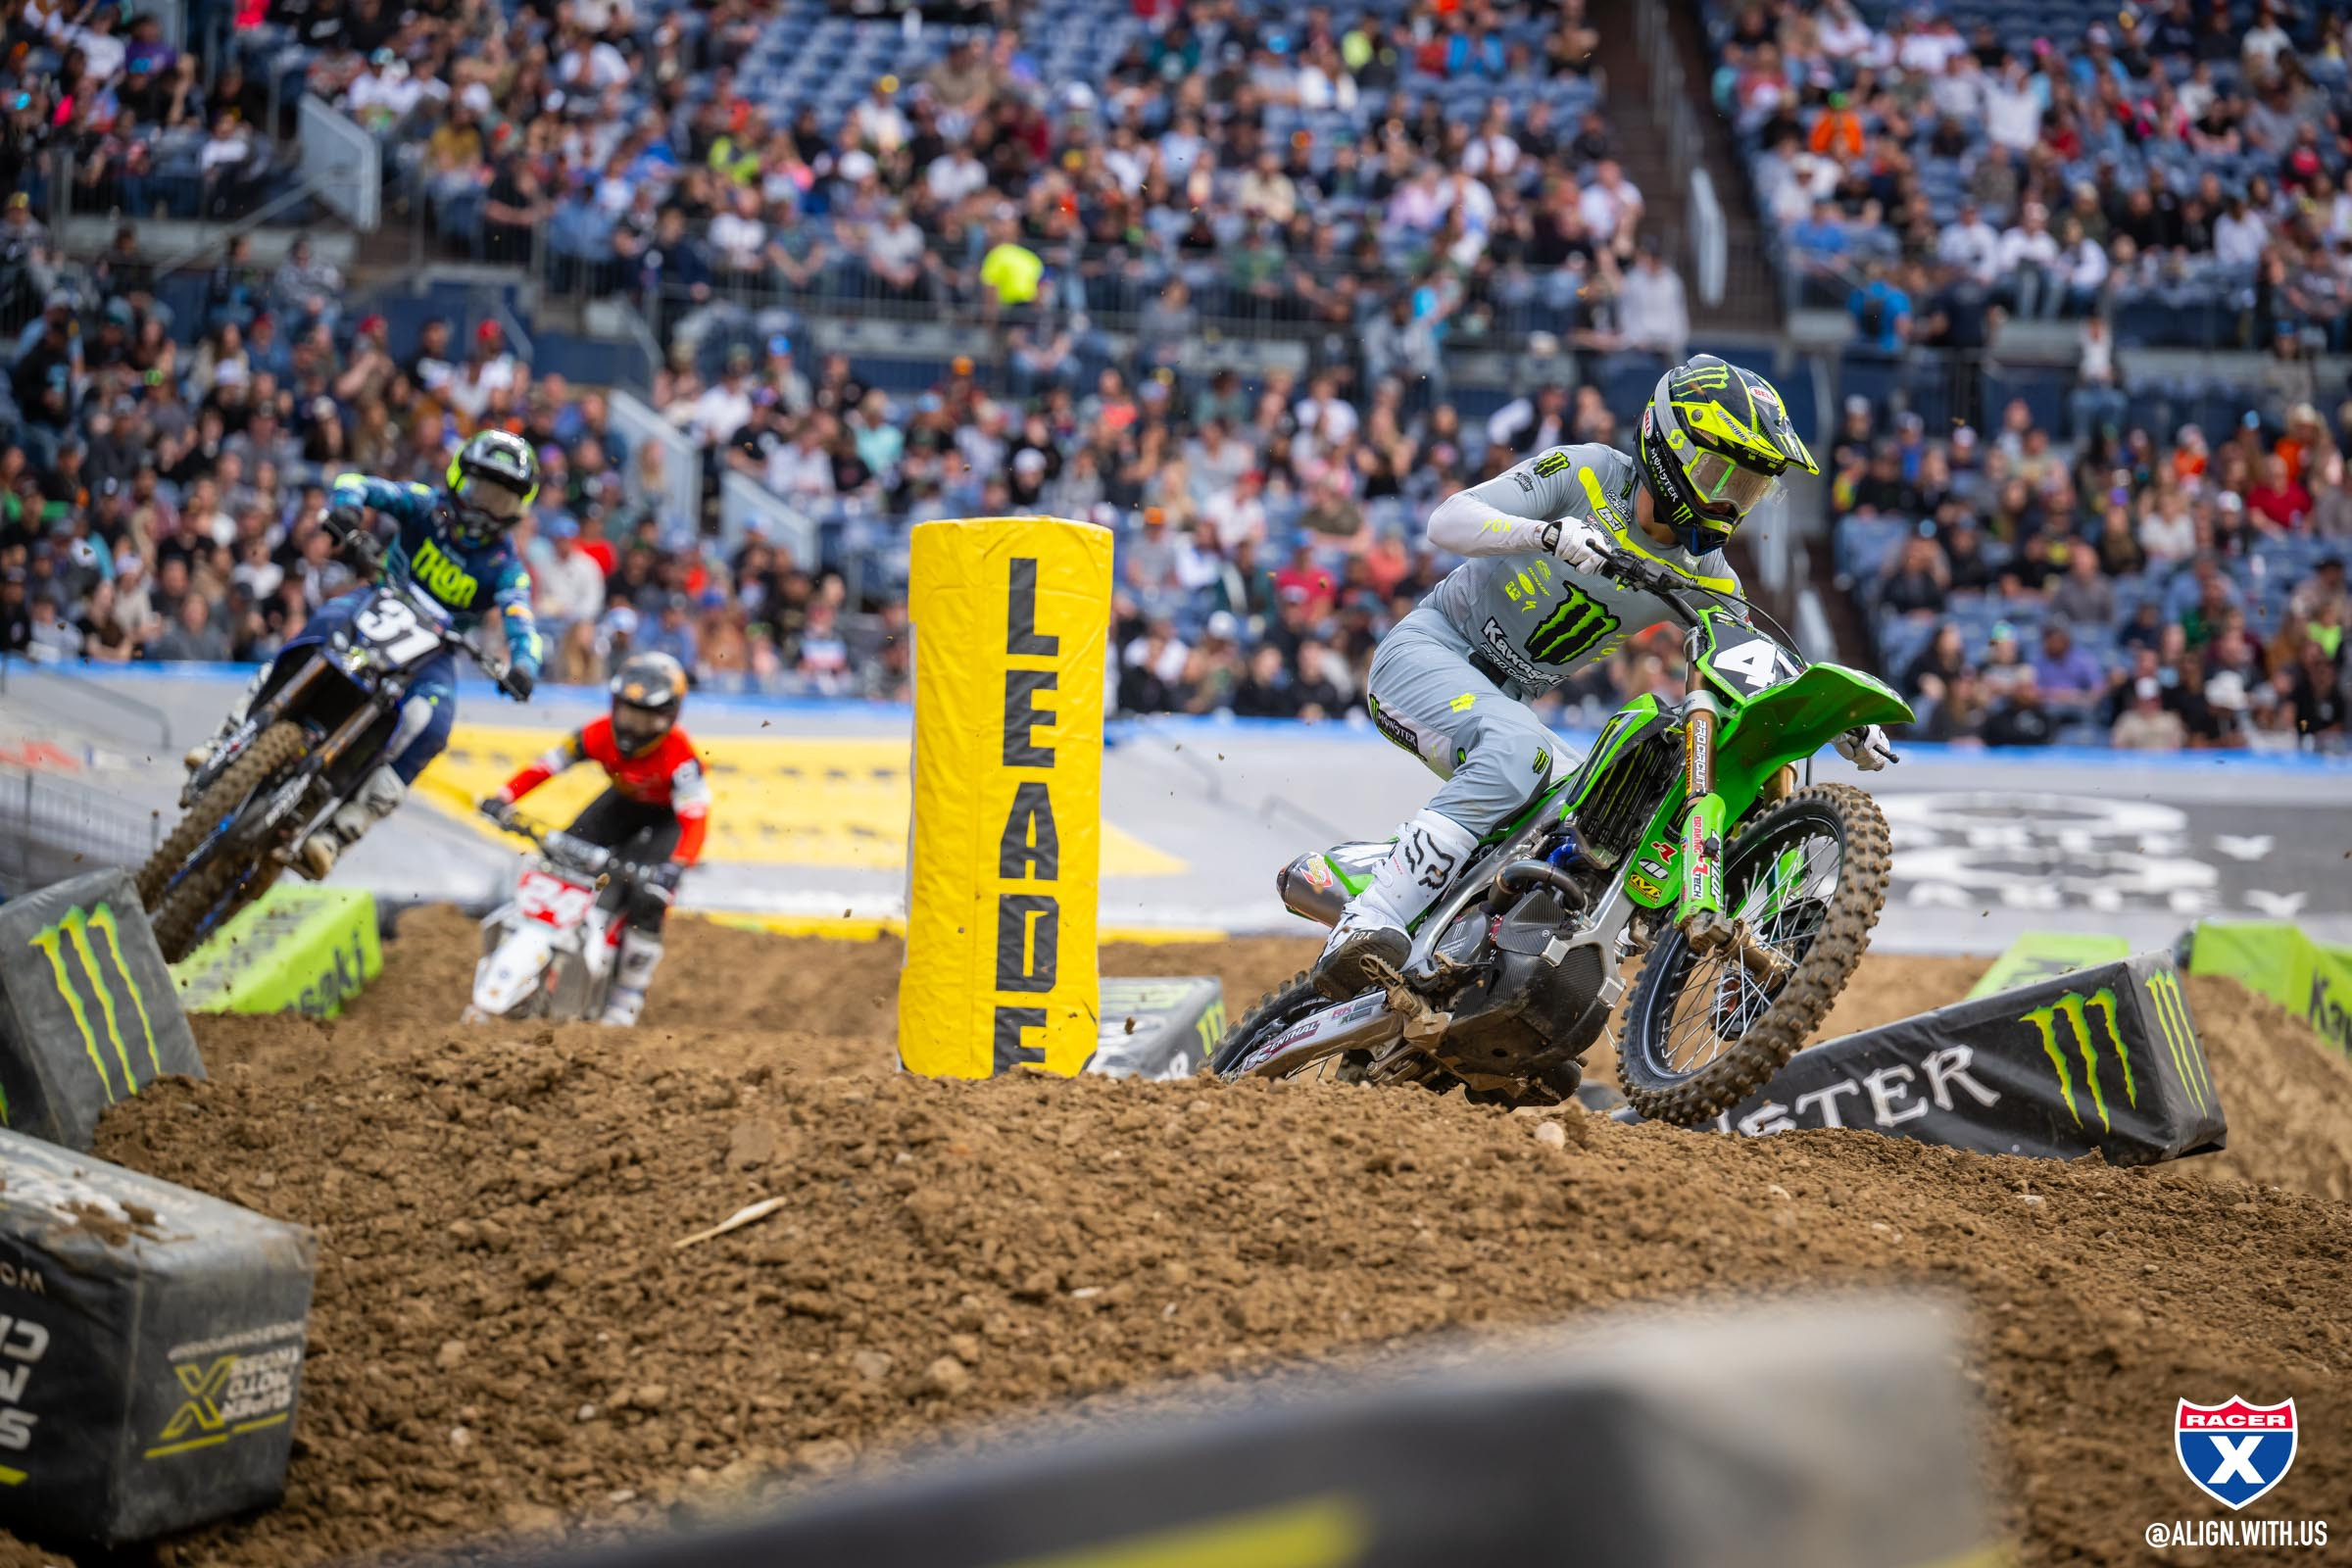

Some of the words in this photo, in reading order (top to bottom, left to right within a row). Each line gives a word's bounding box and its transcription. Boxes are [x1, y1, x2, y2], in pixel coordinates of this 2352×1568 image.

[1752, 387, 1776, 403] BELL
[1643, 410, 1652, 435] BELL
[1649, 446, 1679, 503] MONSTER
[412, 537, 478, 610] THOR
[357, 598, 441, 664] 31
[1482, 617, 1568, 685] Kawasaki
[1378, 711, 1417, 747] MONSTER
[1694, 719, 1706, 744] PRO
[1694, 744, 1706, 794] CIRCUIT
[1692, 815, 1703, 855] BRAKING
[1350, 931, 1374, 941] FOX
